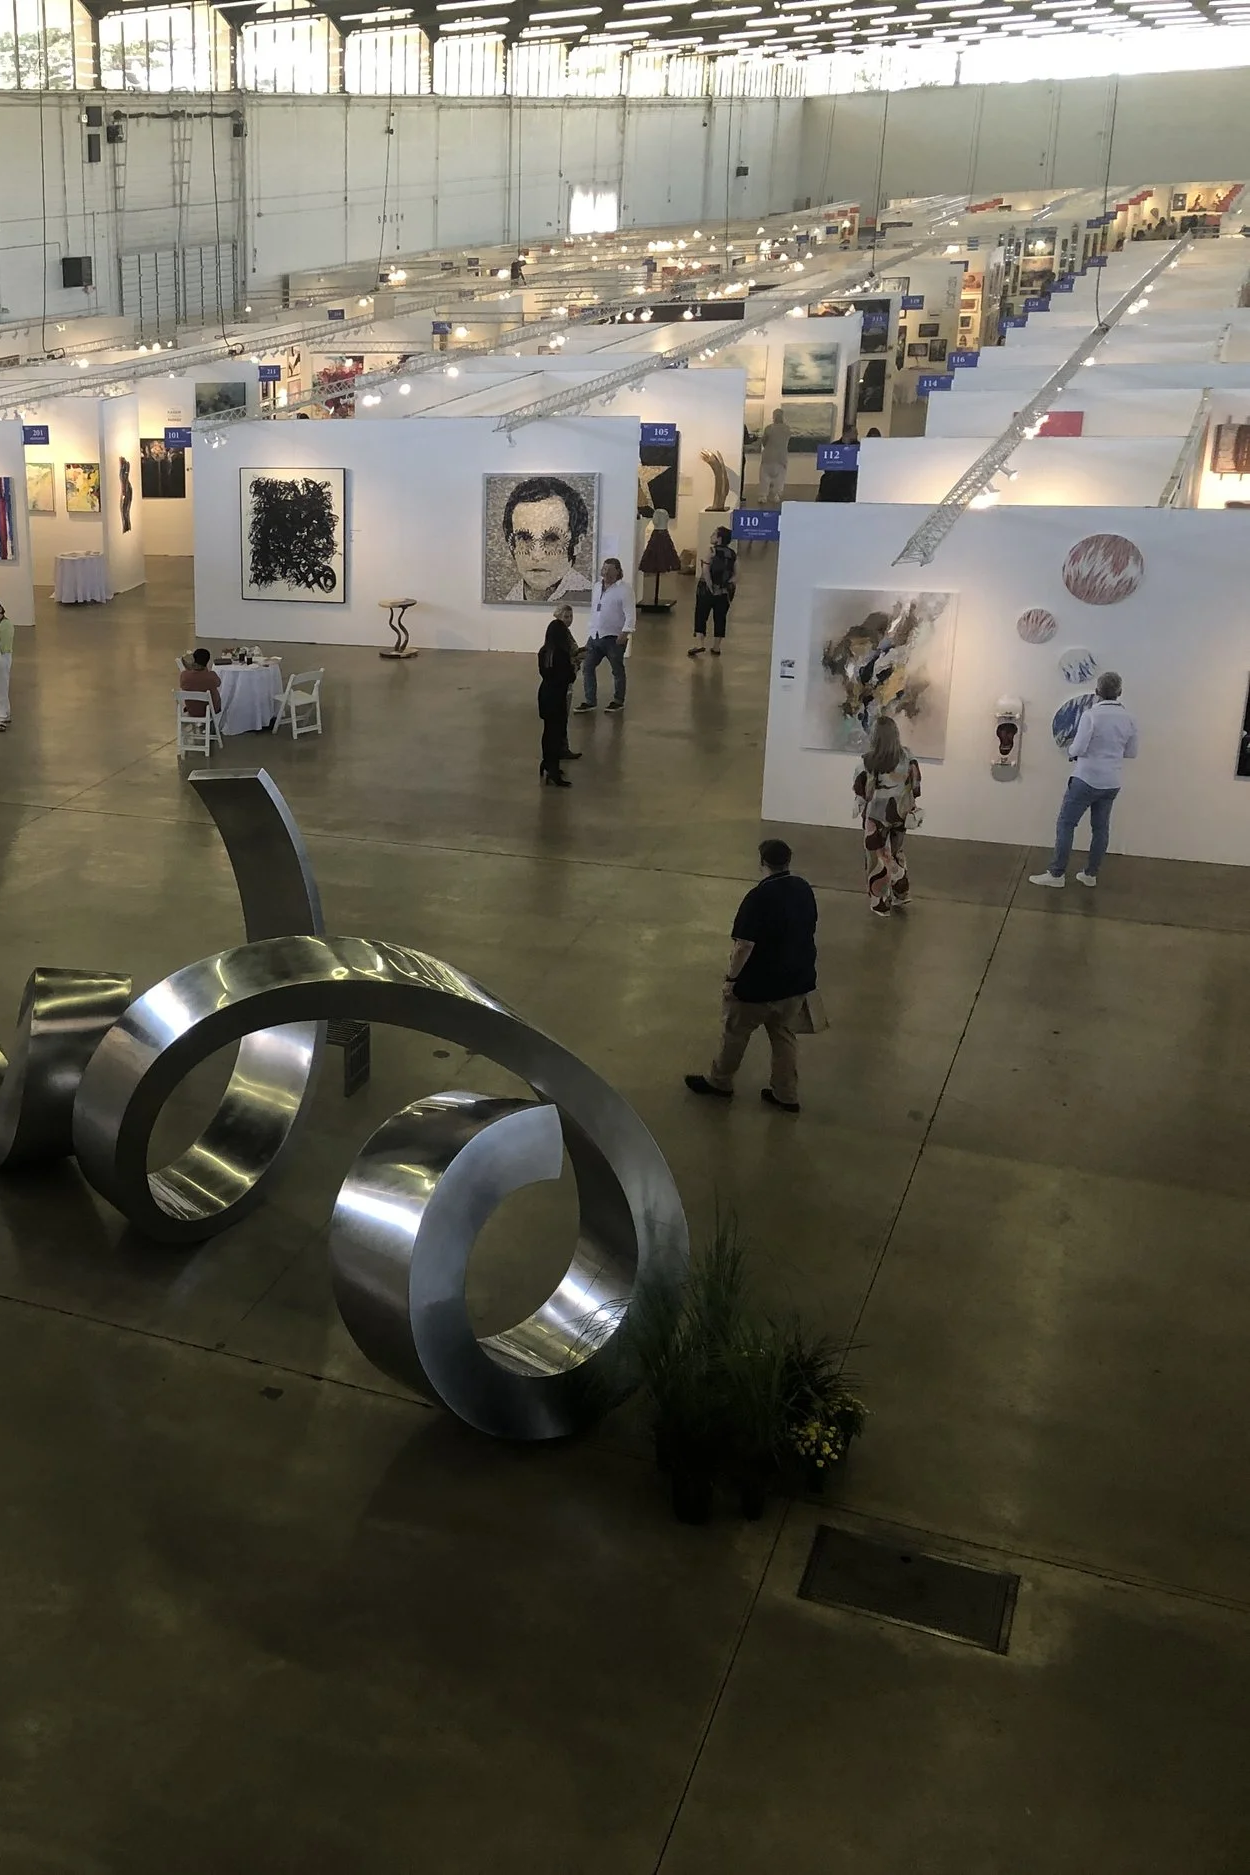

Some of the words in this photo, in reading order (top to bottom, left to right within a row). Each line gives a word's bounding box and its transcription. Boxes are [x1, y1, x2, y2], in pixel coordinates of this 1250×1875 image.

[923, 379, 938, 387] 114
[168, 431, 179, 439] 101
[654, 428, 669, 436] 105
[823, 450, 840, 459] 112
[740, 516, 759, 527] 110
